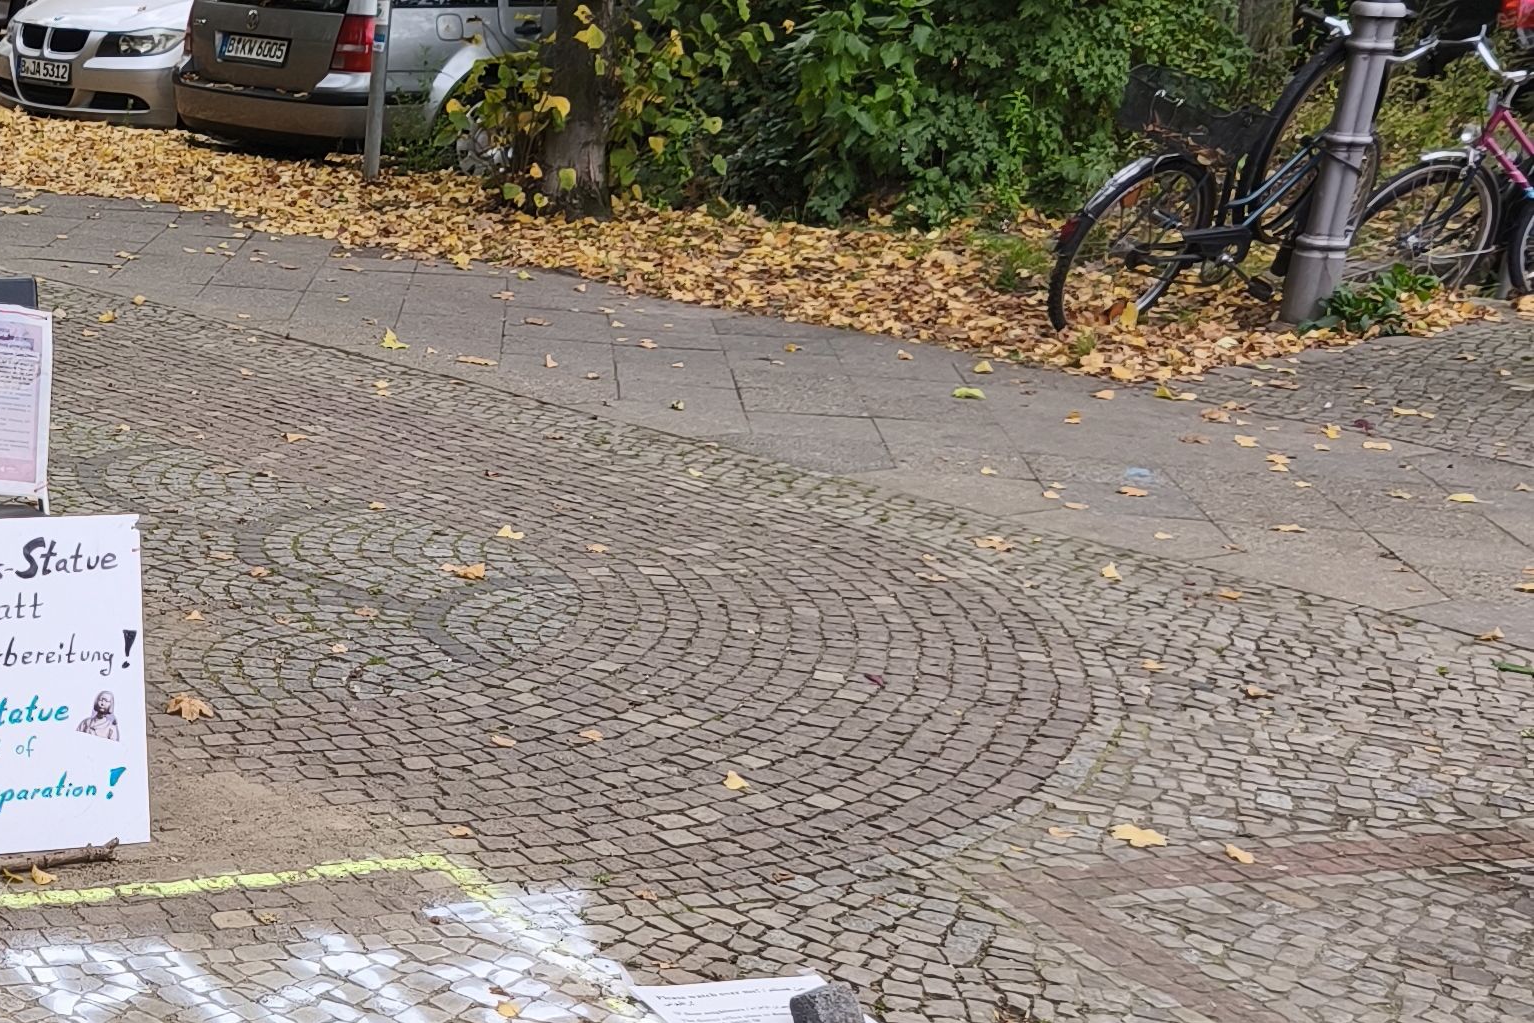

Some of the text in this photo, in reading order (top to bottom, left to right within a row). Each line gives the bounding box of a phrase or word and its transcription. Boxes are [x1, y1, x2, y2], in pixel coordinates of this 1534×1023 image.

[256, 40, 284, 59] 6005
[43, 62, 68, 79] 5312
[15, 735, 38, 758] of
